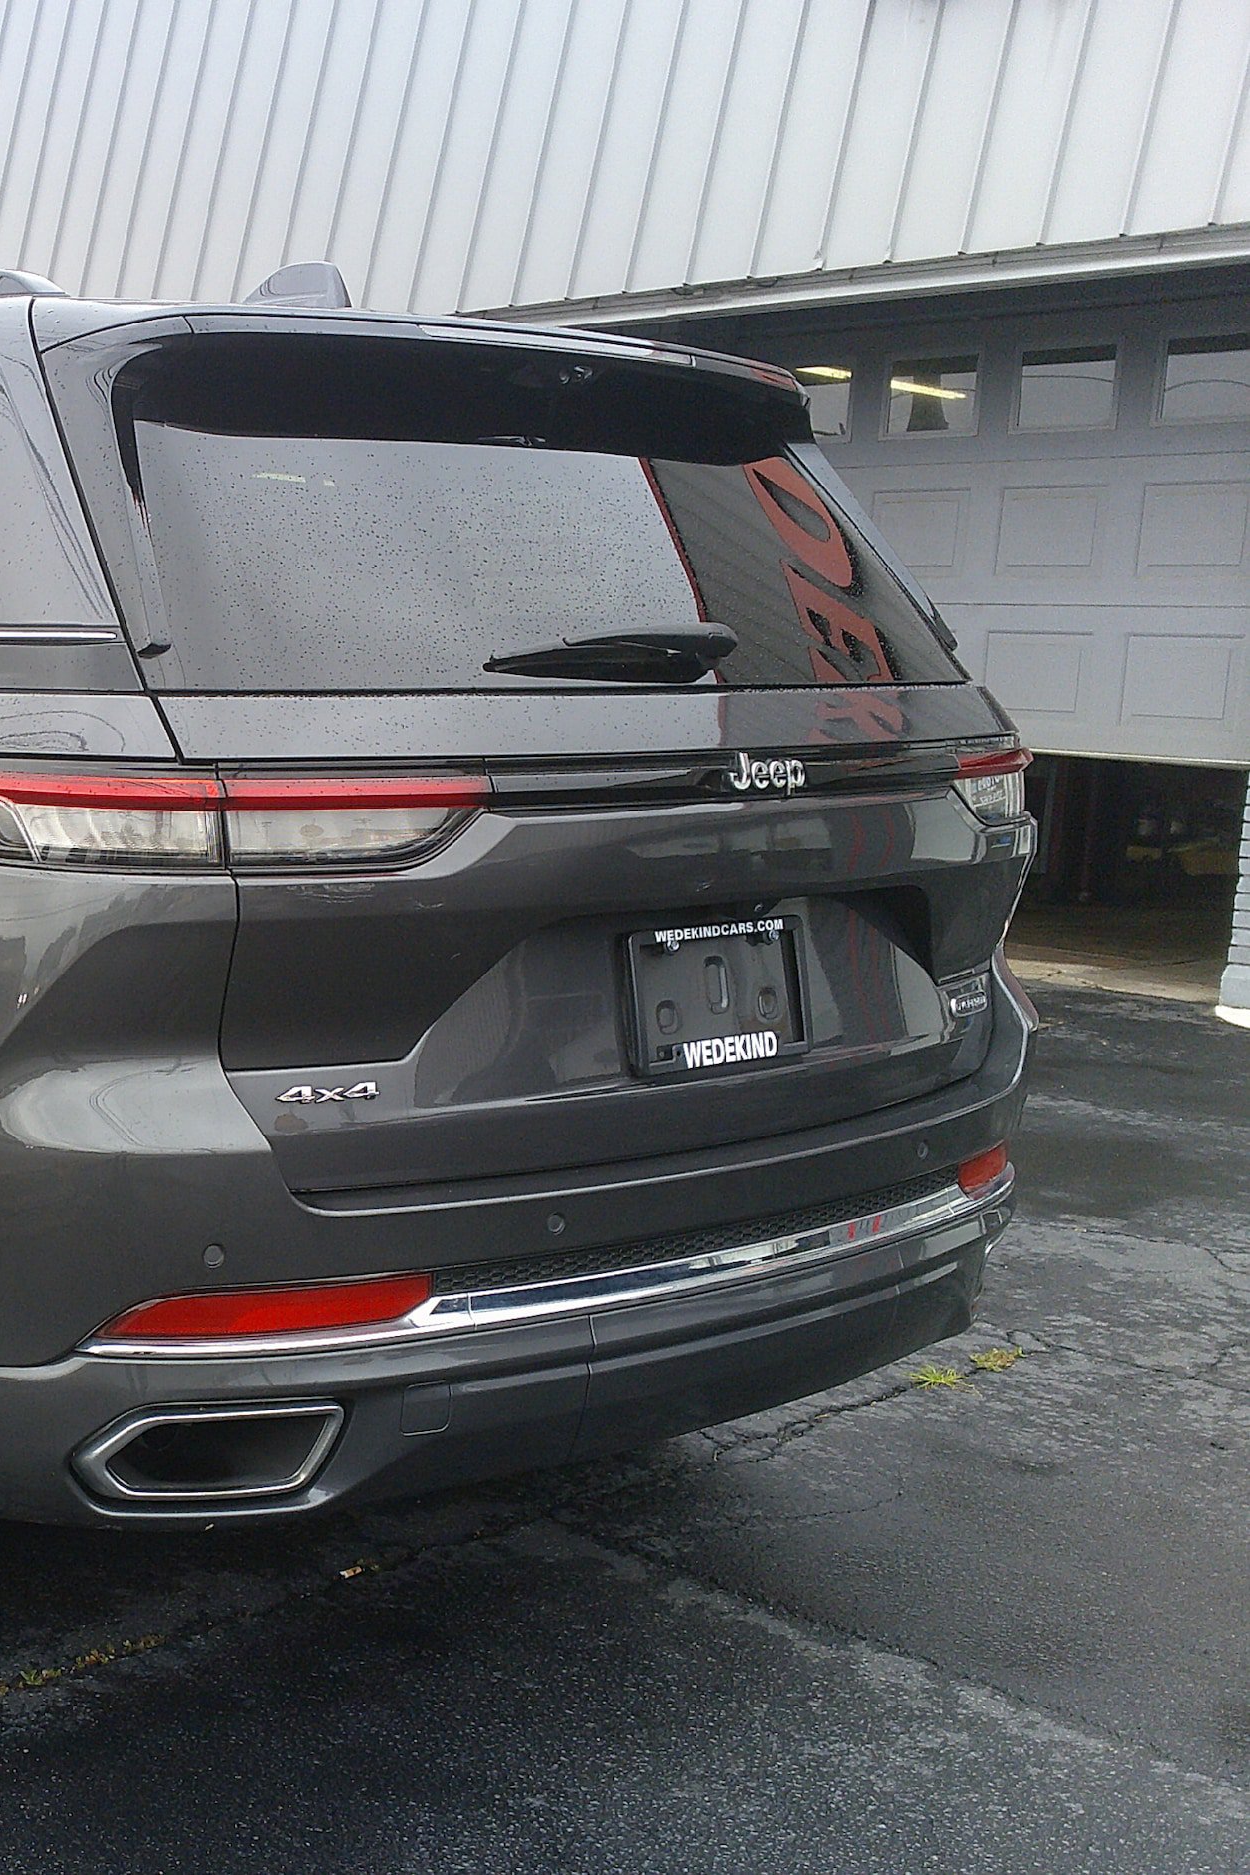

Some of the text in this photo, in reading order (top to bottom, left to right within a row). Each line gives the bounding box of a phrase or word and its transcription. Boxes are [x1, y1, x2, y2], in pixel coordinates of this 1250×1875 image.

[730, 751, 805, 796] Jeep
[655, 918, 783, 943] WEDEKINDCARS.COM
[683, 1030, 778, 1070] WEDEKIND
[276, 1081, 380, 1104] 4x4
